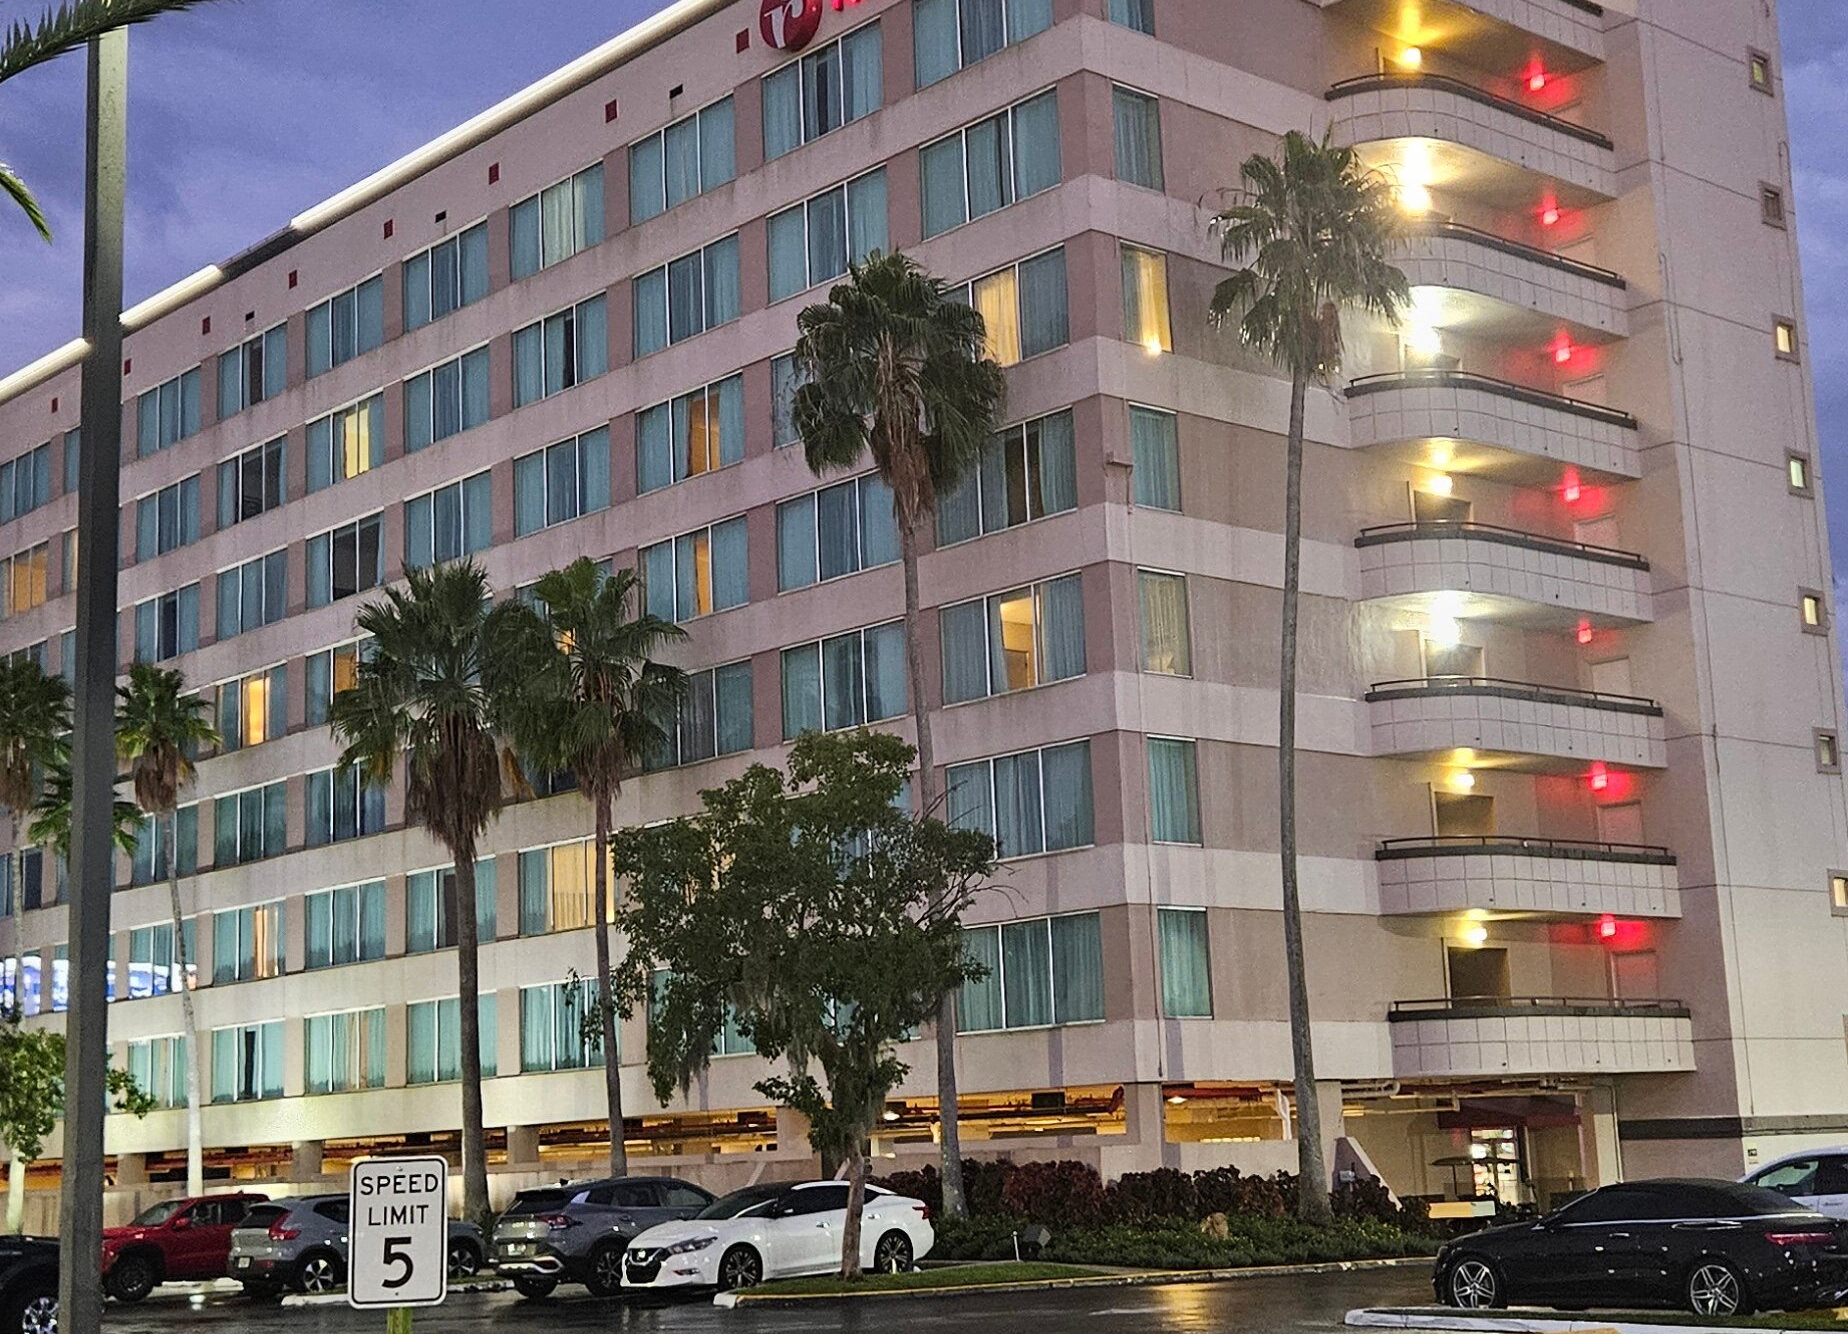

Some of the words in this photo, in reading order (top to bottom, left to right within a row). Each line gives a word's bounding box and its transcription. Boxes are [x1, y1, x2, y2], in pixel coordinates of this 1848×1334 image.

[360, 1173, 439, 1196] SPEED
[368, 1204, 429, 1226] LIMIT
[381, 1236, 414, 1289] 5
